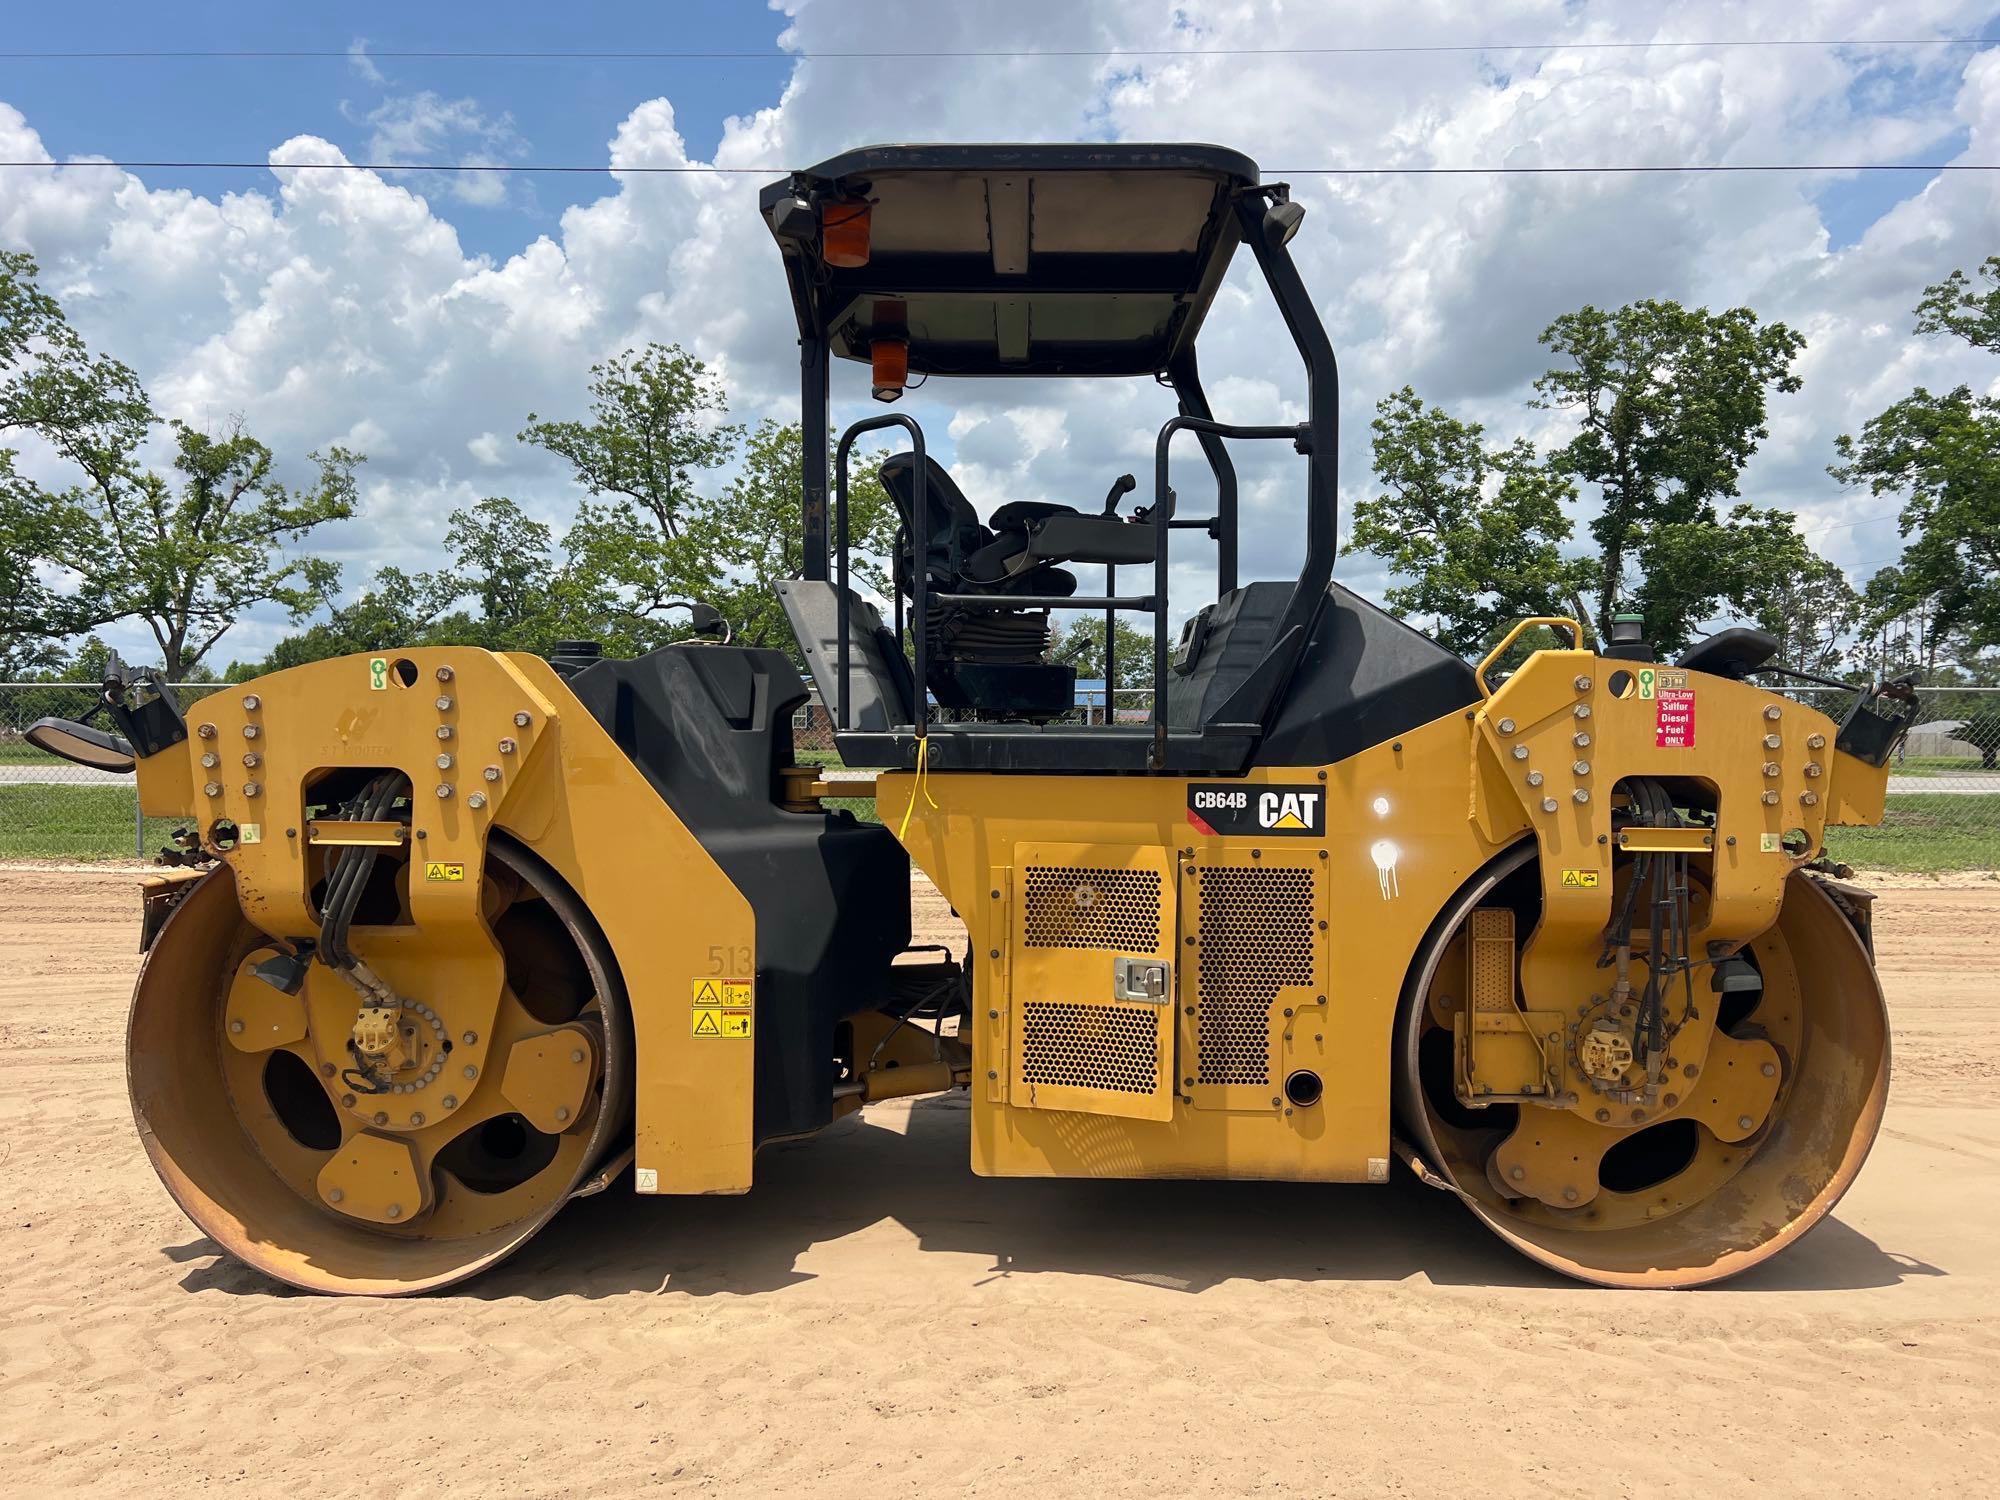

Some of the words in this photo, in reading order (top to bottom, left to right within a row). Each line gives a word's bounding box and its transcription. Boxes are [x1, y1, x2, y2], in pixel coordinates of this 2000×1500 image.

[1658, 690, 1693, 698] Ultra-Low
[1662, 702, 1688, 711] Sulfur
[1661, 713, 1689, 722] Diesel
[1665, 725, 1684, 734] Fuel
[1665, 736, 1685, 744] ONLY
[1195, 791, 1247, 808] CB64B
[1258, 792, 1318, 829] CAT
[708, 945, 753, 976] 513
